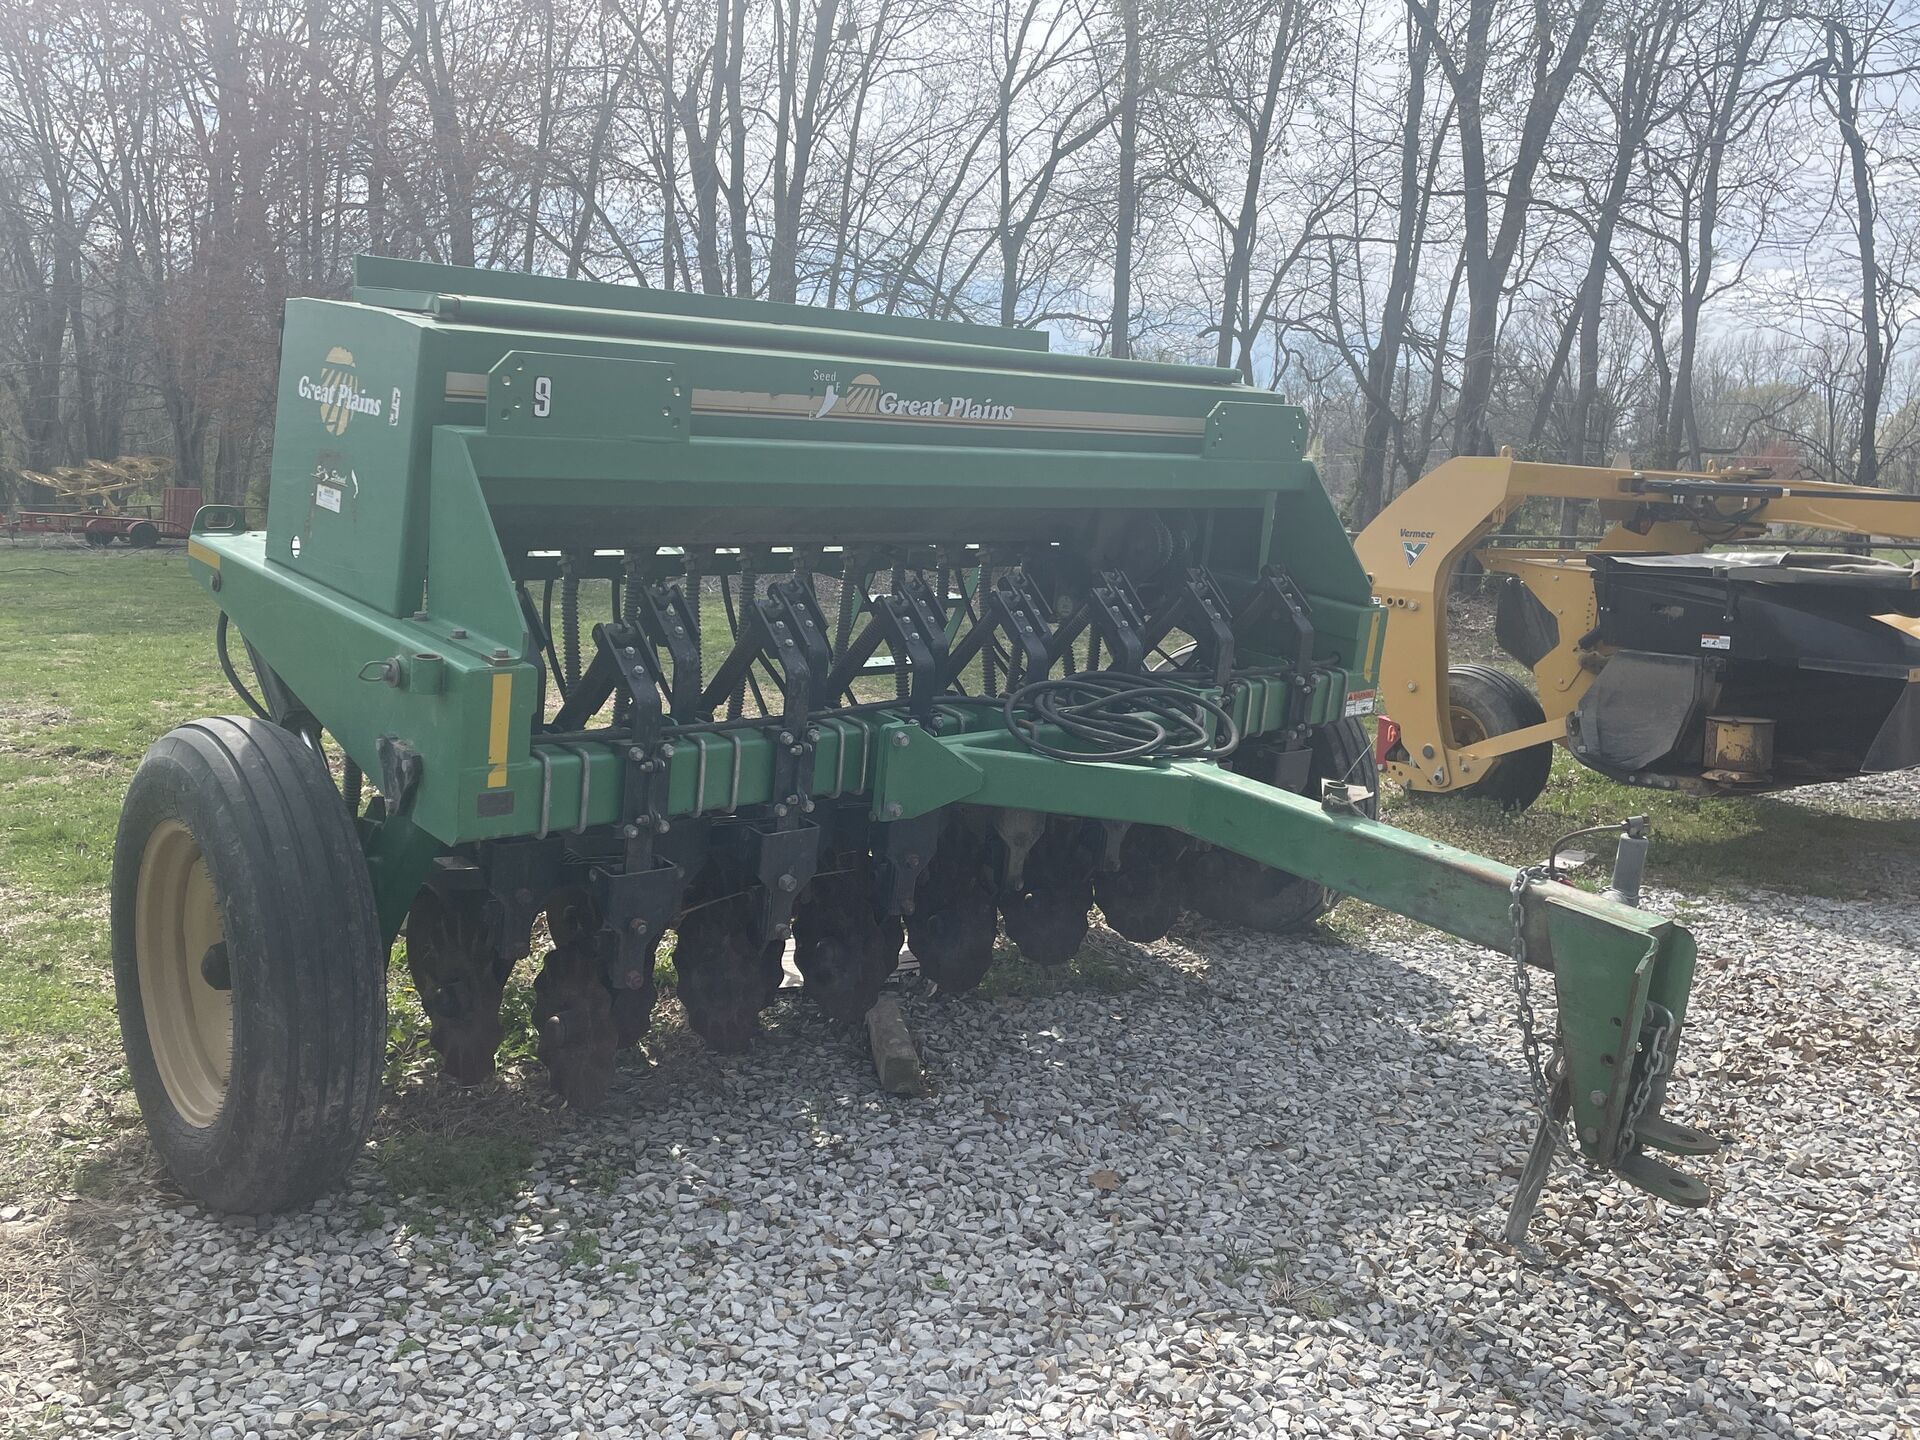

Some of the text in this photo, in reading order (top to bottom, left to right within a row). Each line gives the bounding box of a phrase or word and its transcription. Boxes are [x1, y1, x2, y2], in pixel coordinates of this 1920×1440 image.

[813, 370, 837, 382] Seed
[299, 376, 381, 416] Great Plains
[534, 376, 552, 417] 9
[879, 393, 1014, 421] Great Plains
[1400, 528, 1435, 539] Vermeer
